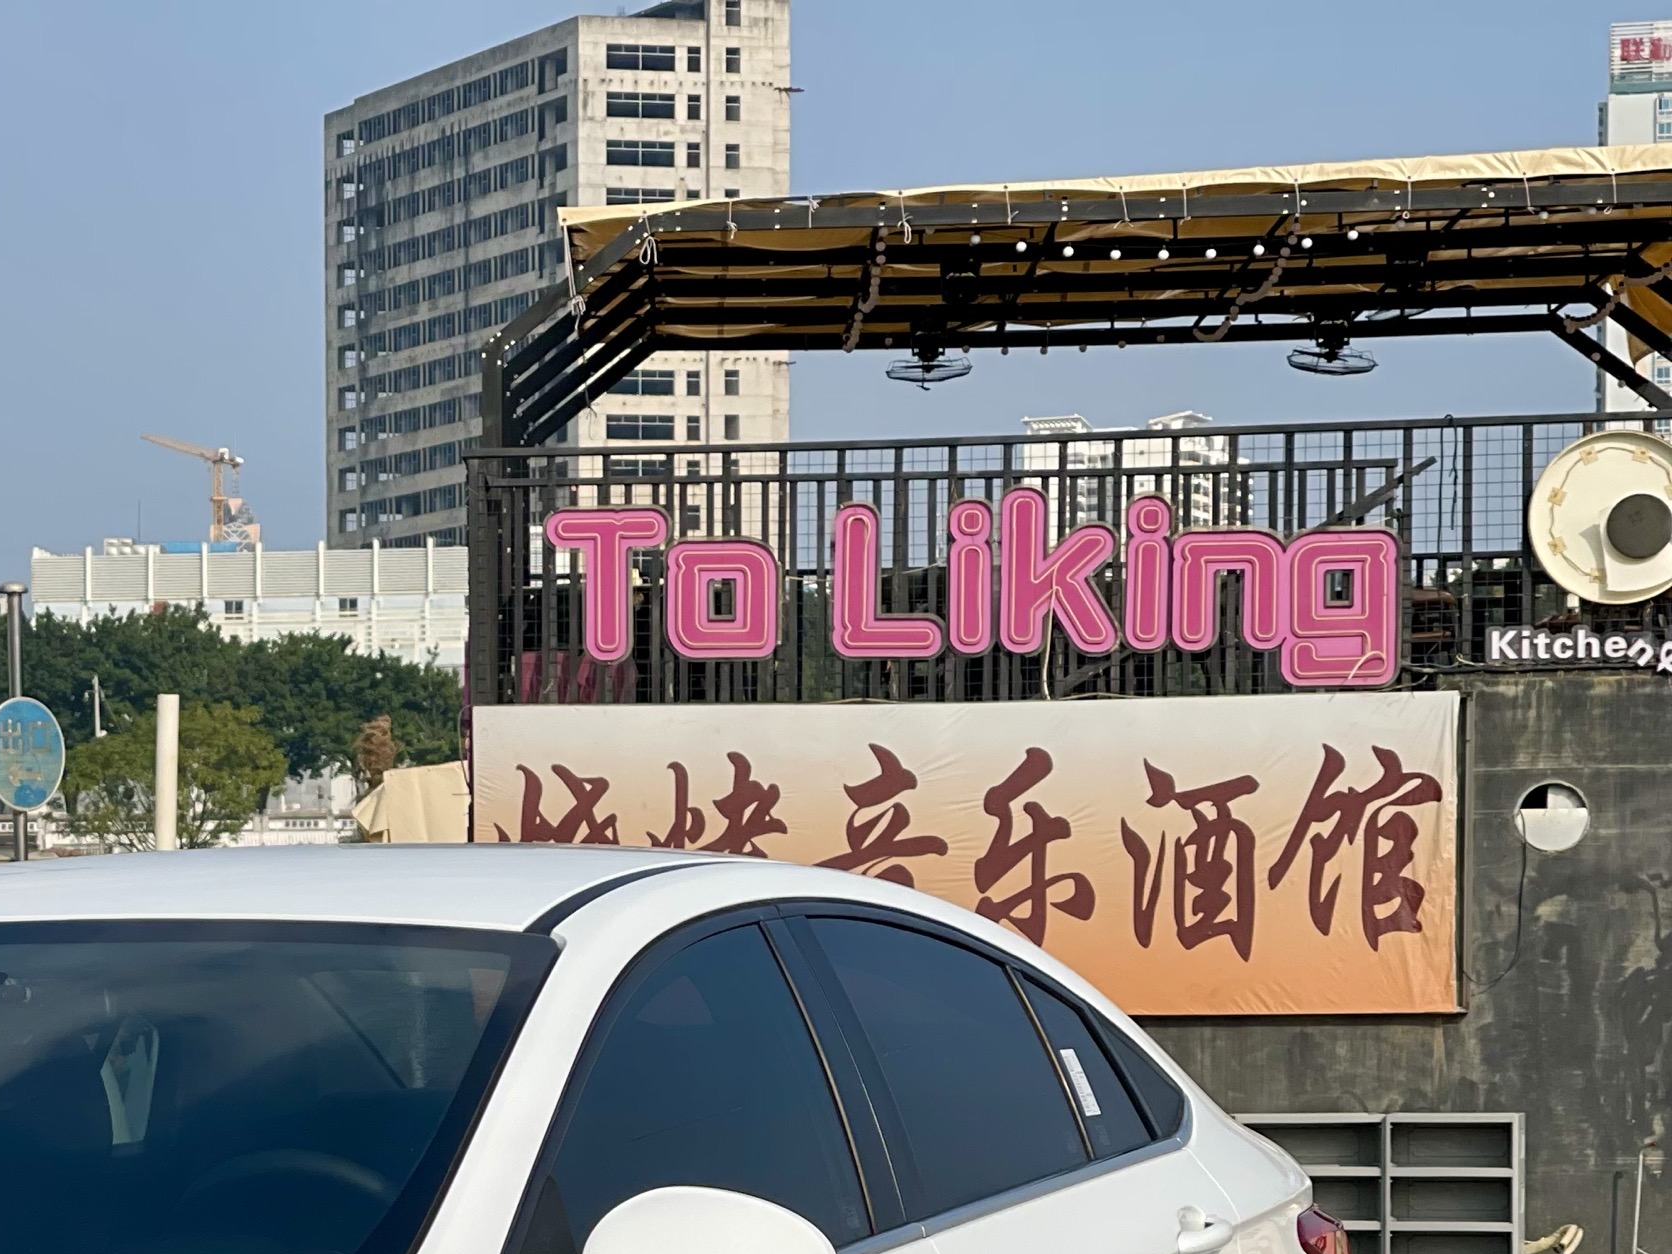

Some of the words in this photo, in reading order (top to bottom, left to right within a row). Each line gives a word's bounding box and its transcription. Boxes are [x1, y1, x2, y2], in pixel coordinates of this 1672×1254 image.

[545, 504, 783, 662] To
[833, 487, 1402, 686] Liking
[1491, 629, 1654, 667] Kitchen
[0, 719, 50, 754] 出口
